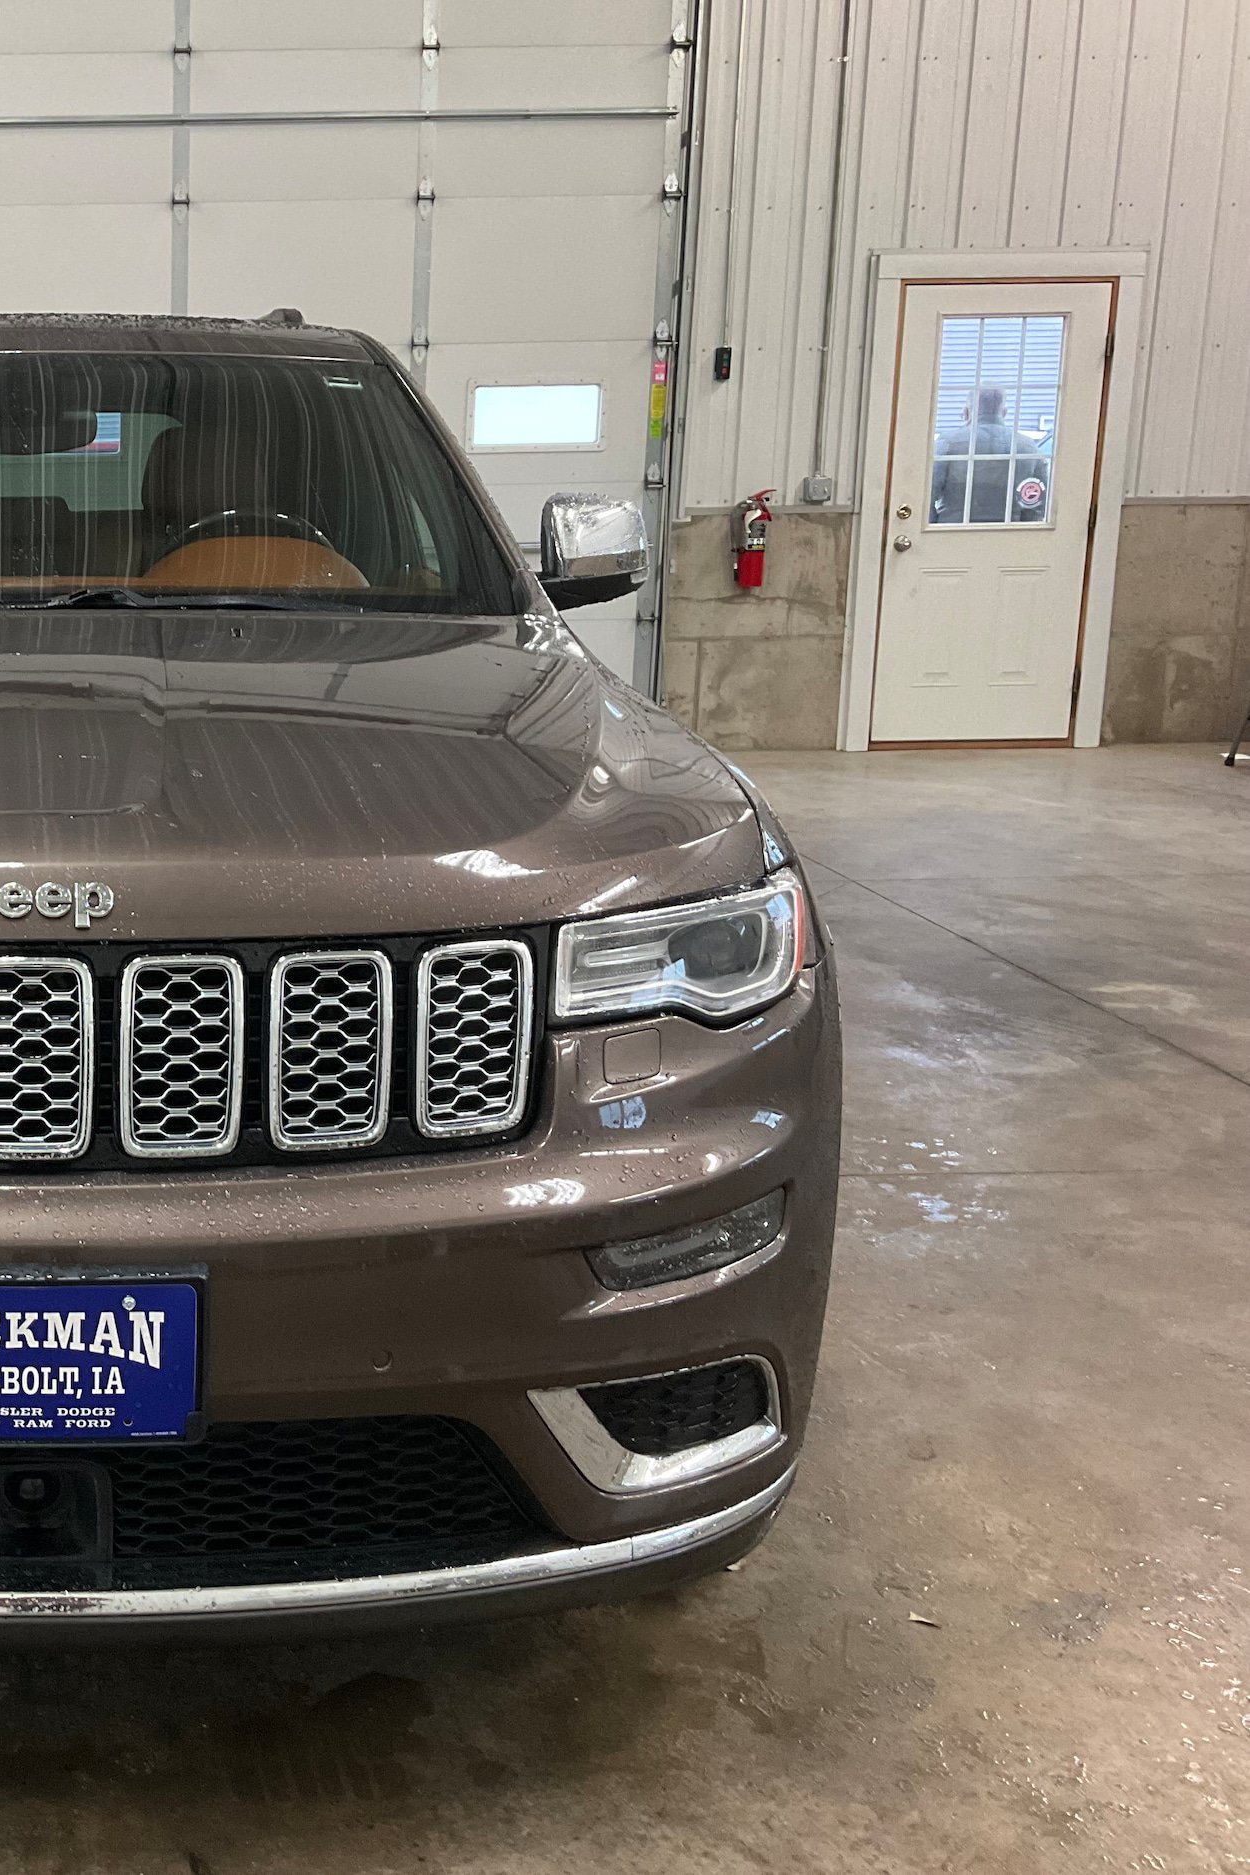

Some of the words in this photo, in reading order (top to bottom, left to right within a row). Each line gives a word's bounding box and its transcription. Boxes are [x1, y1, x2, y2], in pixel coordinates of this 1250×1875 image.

[91, 1366, 126, 1395] IA
[56, 1406, 116, 1417] DODGE
[13, 1418, 54, 1429] RAM
[64, 1418, 112, 1429] FORD
